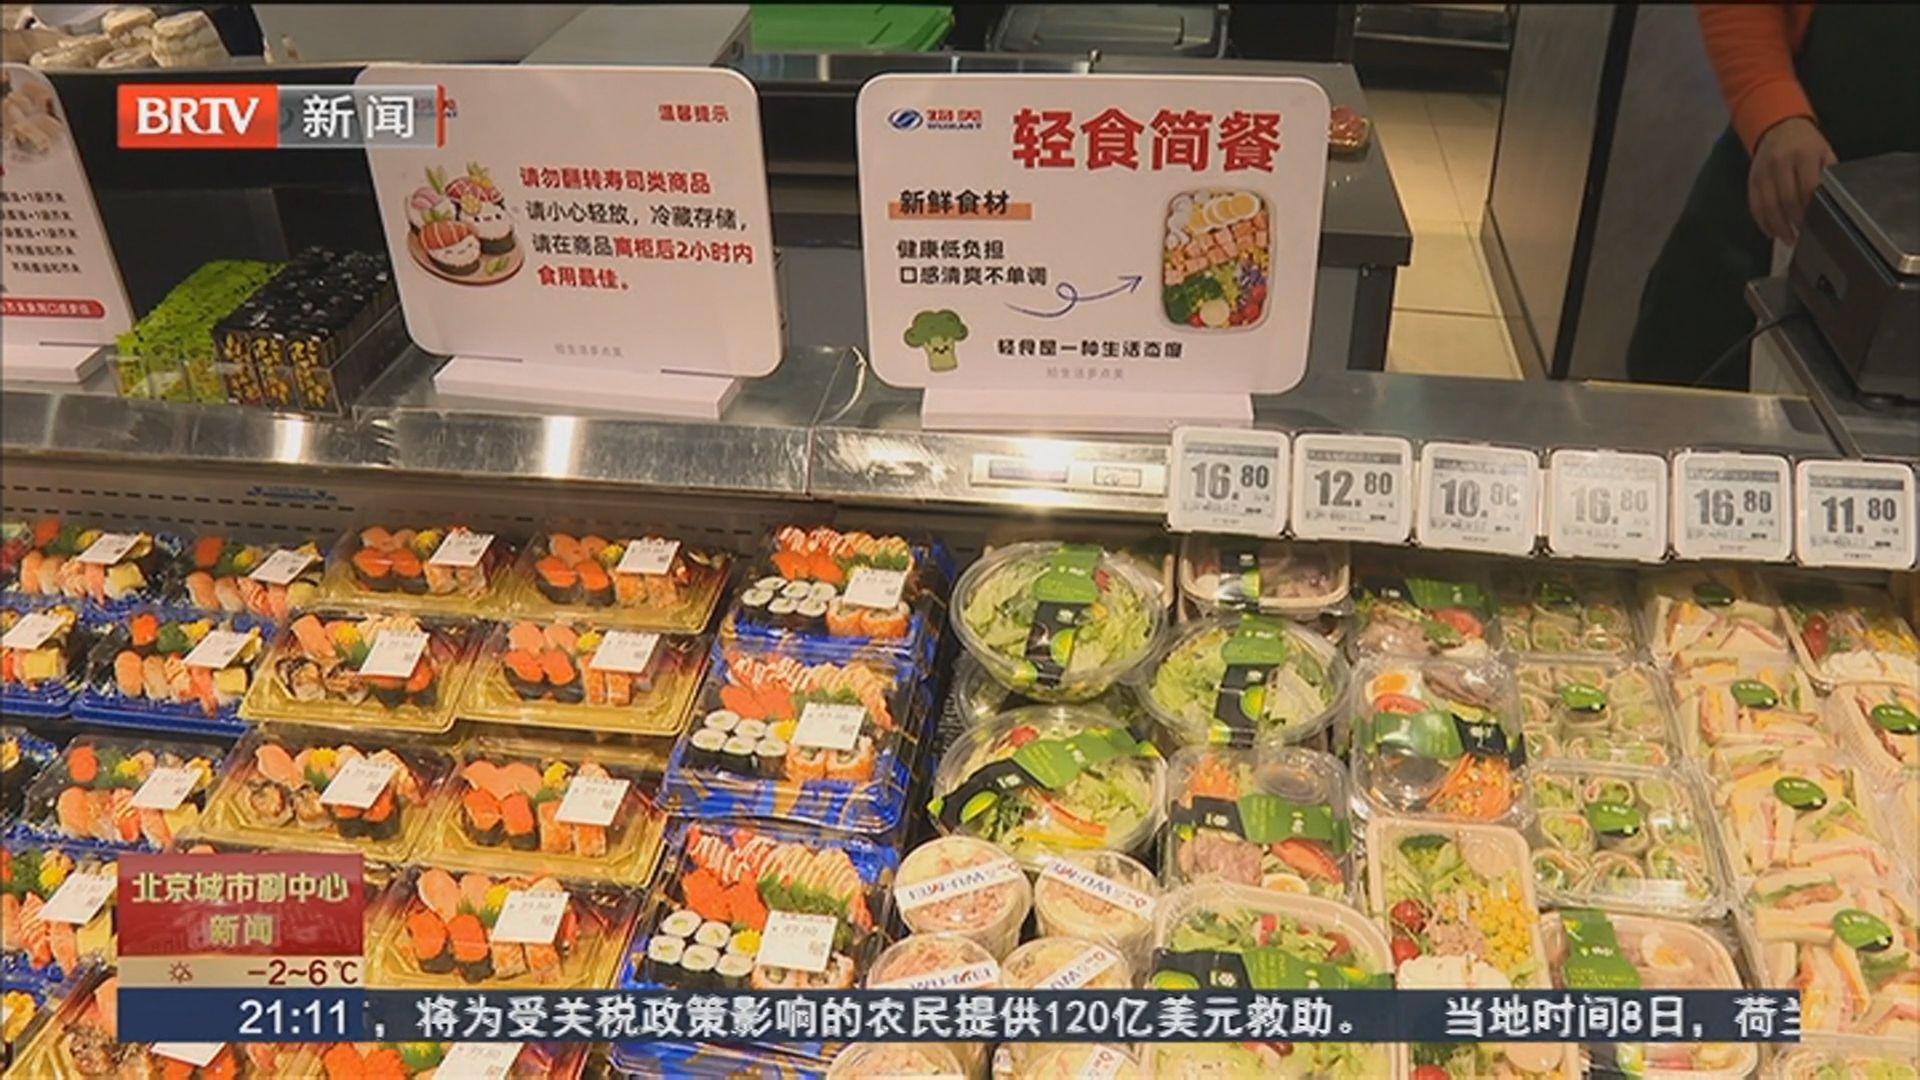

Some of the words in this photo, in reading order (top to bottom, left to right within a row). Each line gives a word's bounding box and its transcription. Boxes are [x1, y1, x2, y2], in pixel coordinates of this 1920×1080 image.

[1013, 108, 1281, 172] 轻食简餐
[519, 167, 711, 194] 请勿翻转寿司类商品
[900, 189, 1010, 215] 新鲜食材
[532, 233, 754, 264] 请在商品离柜后2小时内
[897, 239, 1005, 259] 健康低负担
[537, 264, 629, 290] 食用最佳。
[900, 266, 1047, 285] 口感清爽不单调
[998, 339, 1183, 358] 轻食是一种生活态度
[1191, 461, 1270, 501] 16.80
[1315, 470, 1393, 508] 12.80
[1572, 485, 1648, 525] 16.80
[1694, 488, 1772, 527] 16.80
[1822, 496, 1897, 534] 11.80
